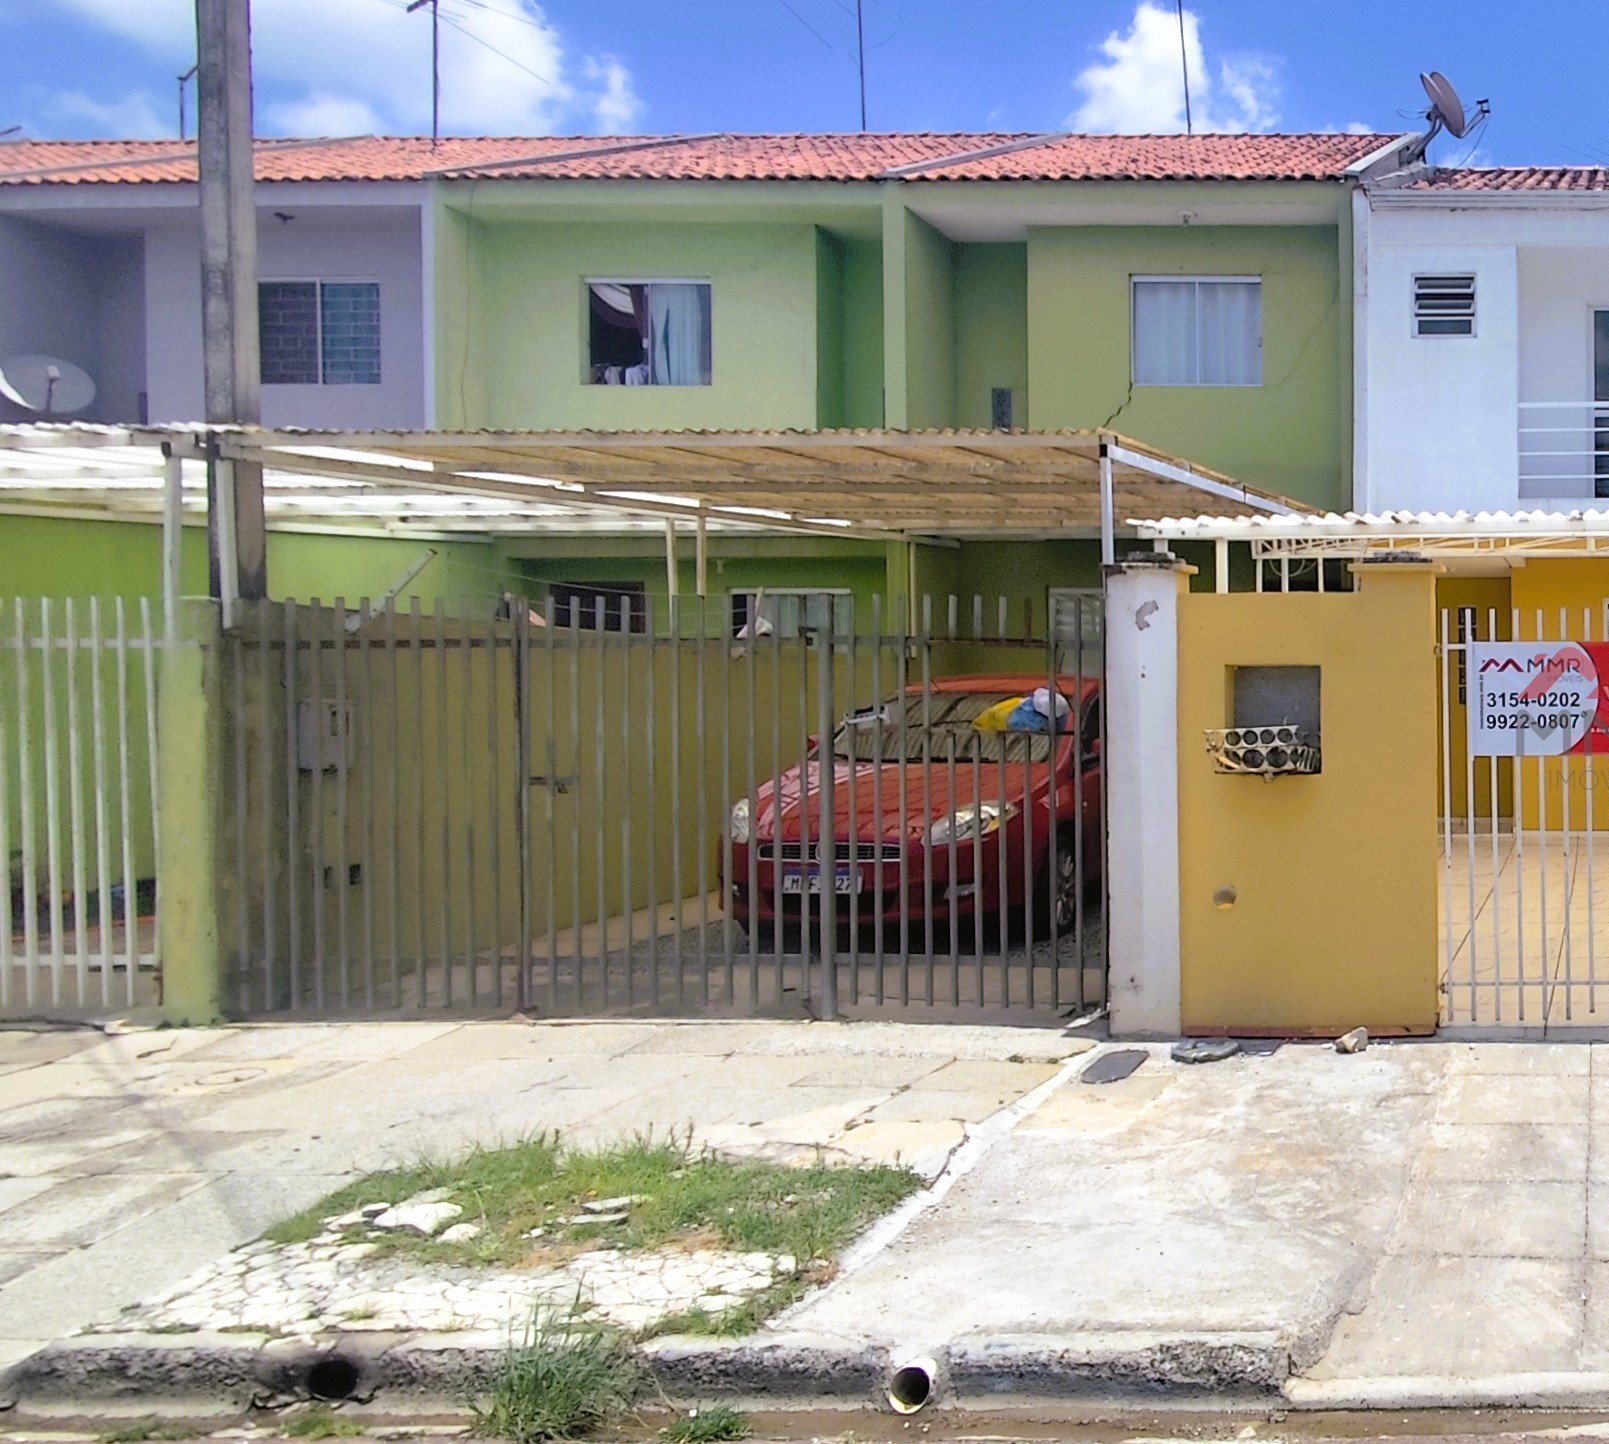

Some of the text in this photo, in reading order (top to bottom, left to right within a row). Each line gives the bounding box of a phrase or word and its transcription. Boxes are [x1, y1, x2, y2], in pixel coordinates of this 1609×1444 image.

[1527, 658, 1581, 673] MMR
[1486, 692, 1580, 708] 3154-0202
[1486, 713, 1580, 730] 9922-0807
